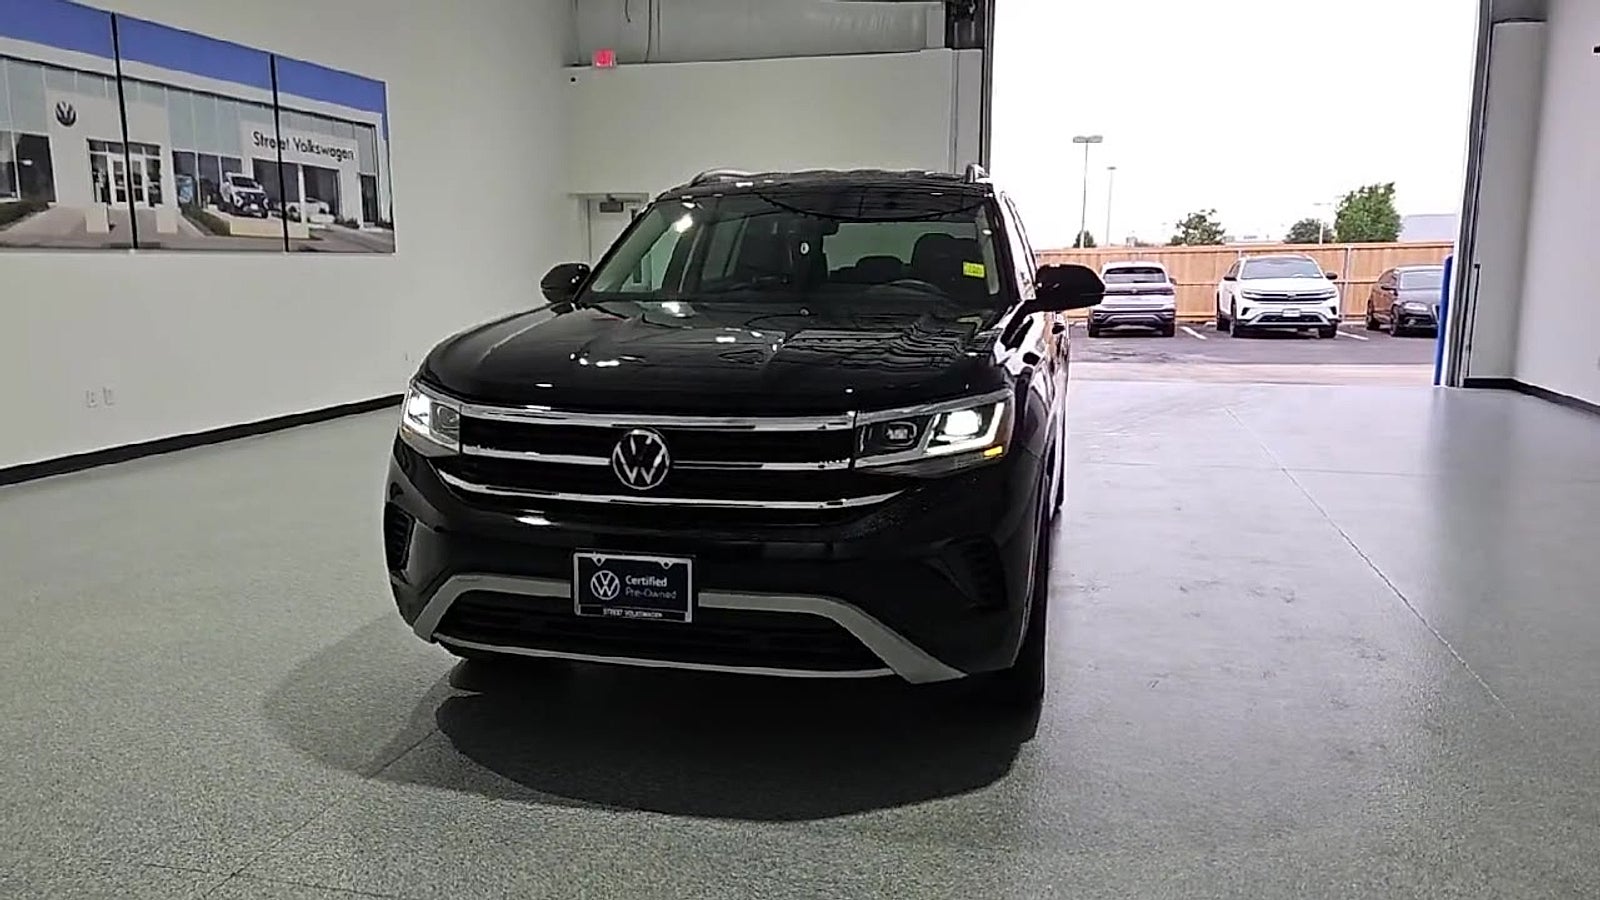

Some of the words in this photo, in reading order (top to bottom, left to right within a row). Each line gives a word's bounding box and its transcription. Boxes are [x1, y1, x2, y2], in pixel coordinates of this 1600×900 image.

[253, 131, 290, 151] Street
[293, 137, 354, 162] Volkswagen
[625, 575, 668, 587] Certified
[625, 586, 677, 599] Pre-Owned
